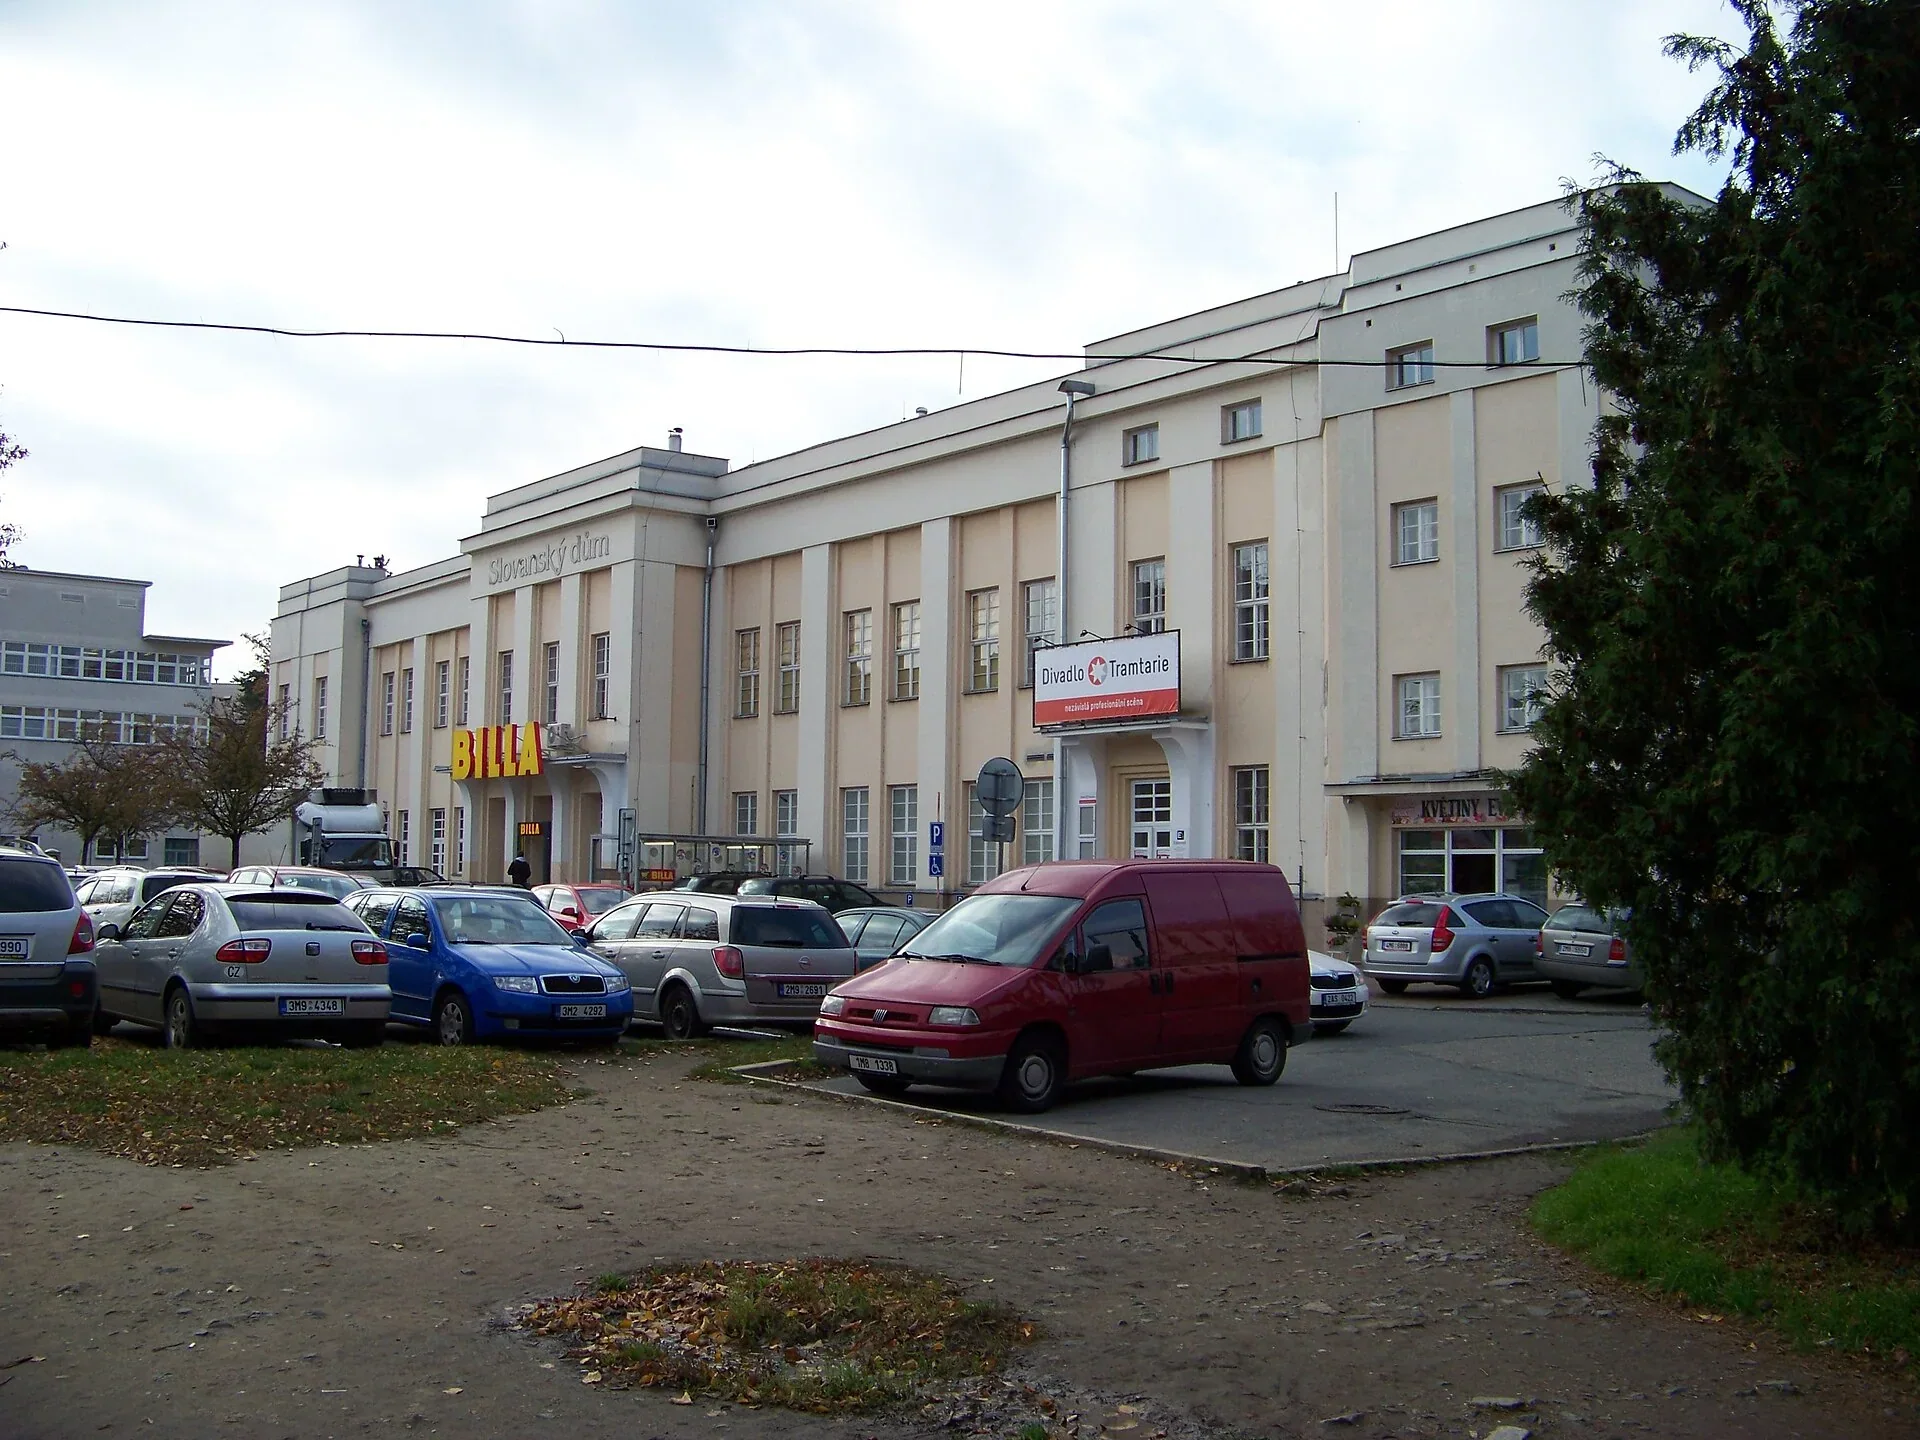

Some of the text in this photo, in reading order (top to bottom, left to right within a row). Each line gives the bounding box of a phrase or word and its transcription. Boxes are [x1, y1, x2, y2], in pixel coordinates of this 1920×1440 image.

[489, 531, 610, 585] Slovanský dům
[1042, 655, 1169, 685] Divadlo Tramtarie
[1126, 697, 1144, 707] scéna
[452, 721, 544, 780] BILLA
[520, 823, 540, 835] BILLA
[934, 826, 940, 842] P
[651, 870, 674, 881] BILLA
[227, 966, 240, 978] CZ
[785, 985, 823, 995] 2M9 2691
[288, 1001, 338, 1011] 3M9 4348
[562, 1006, 603, 1016] 3M2 4292
[875, 1059, 894, 1071] 1338
